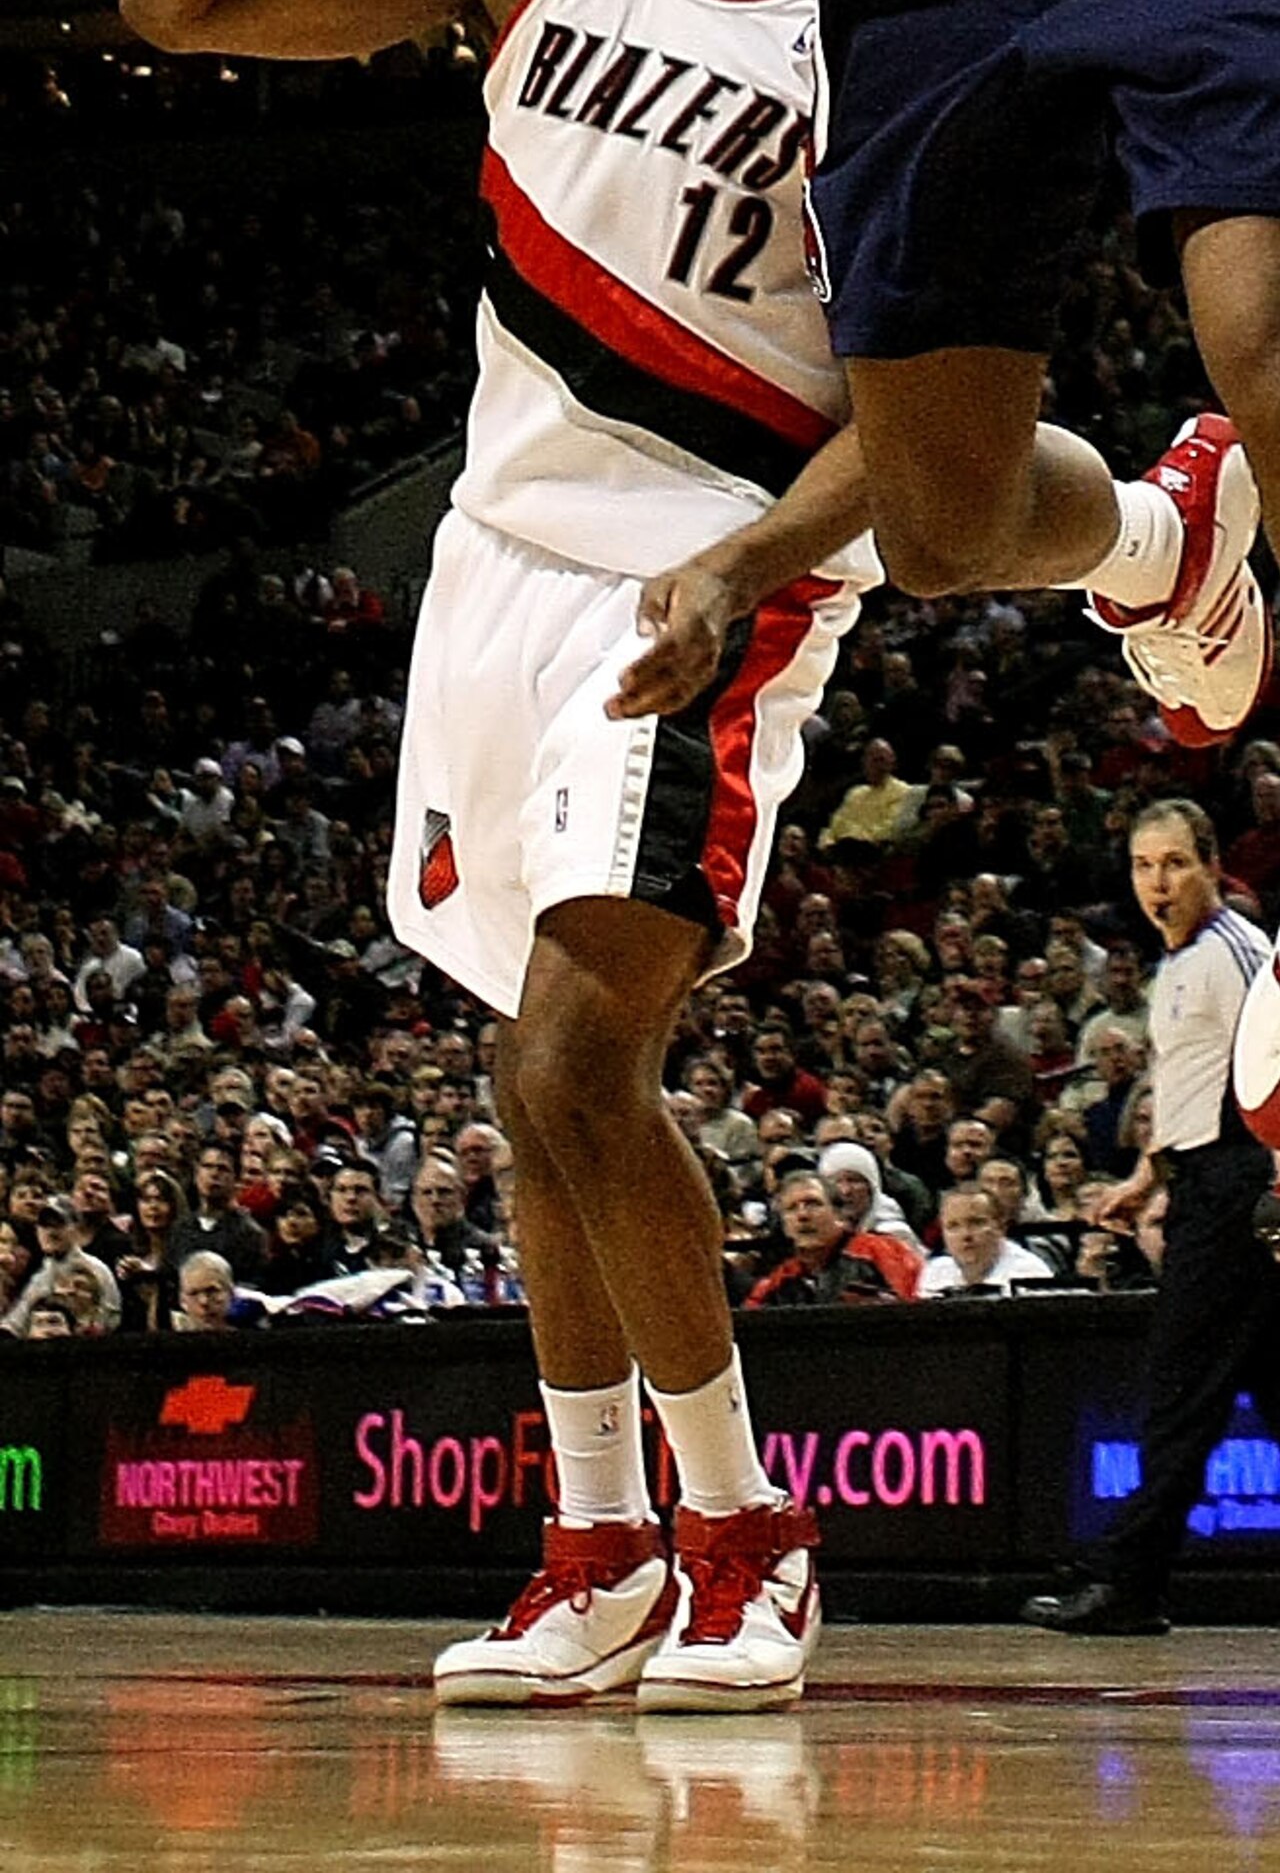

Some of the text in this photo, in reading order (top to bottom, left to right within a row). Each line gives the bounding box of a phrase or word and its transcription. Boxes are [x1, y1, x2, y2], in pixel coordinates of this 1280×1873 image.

[517, 20, 812, 191] BLAZERS
[665, 180, 774, 304] 12
[116, 1459, 304, 1508] NORTHWEST
